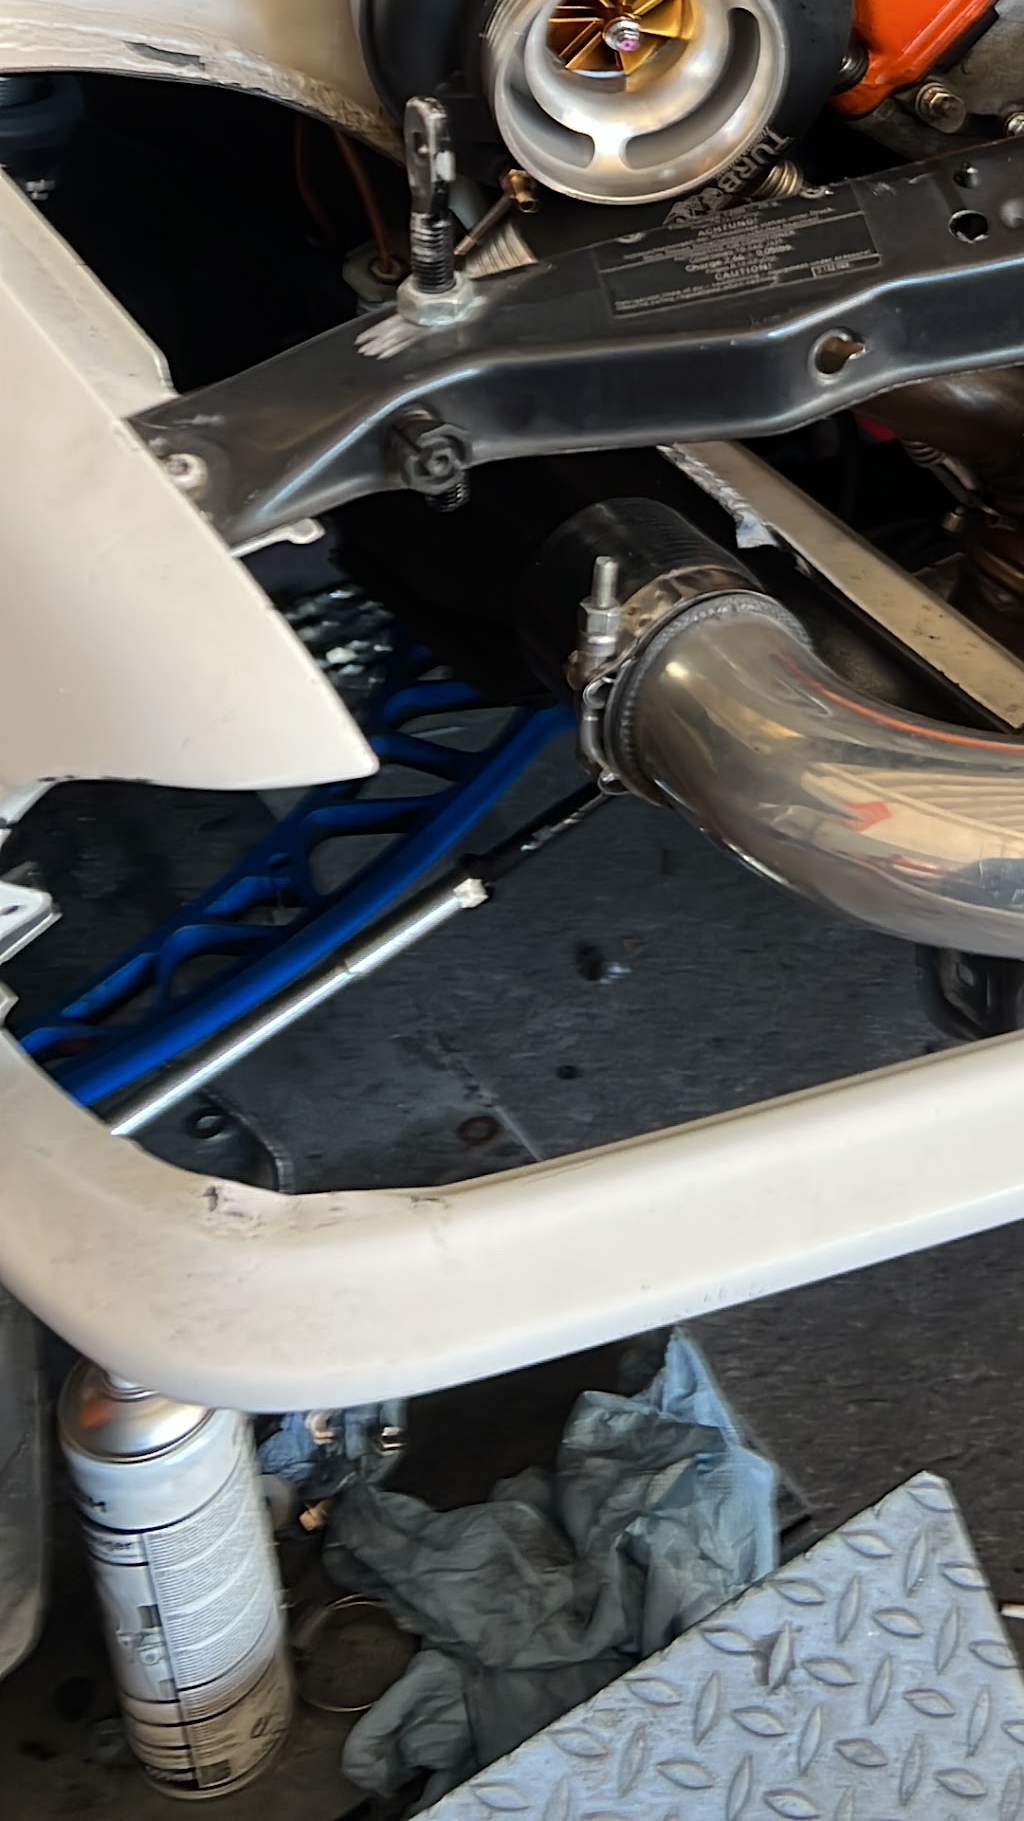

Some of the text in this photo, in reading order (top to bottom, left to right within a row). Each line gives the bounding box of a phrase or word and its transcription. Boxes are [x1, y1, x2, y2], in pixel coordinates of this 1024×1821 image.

[697, 218, 757, 236] ACHTUNG!
[685, 259, 722, 272] Charge
[715, 262, 772, 281] CAUTION!
